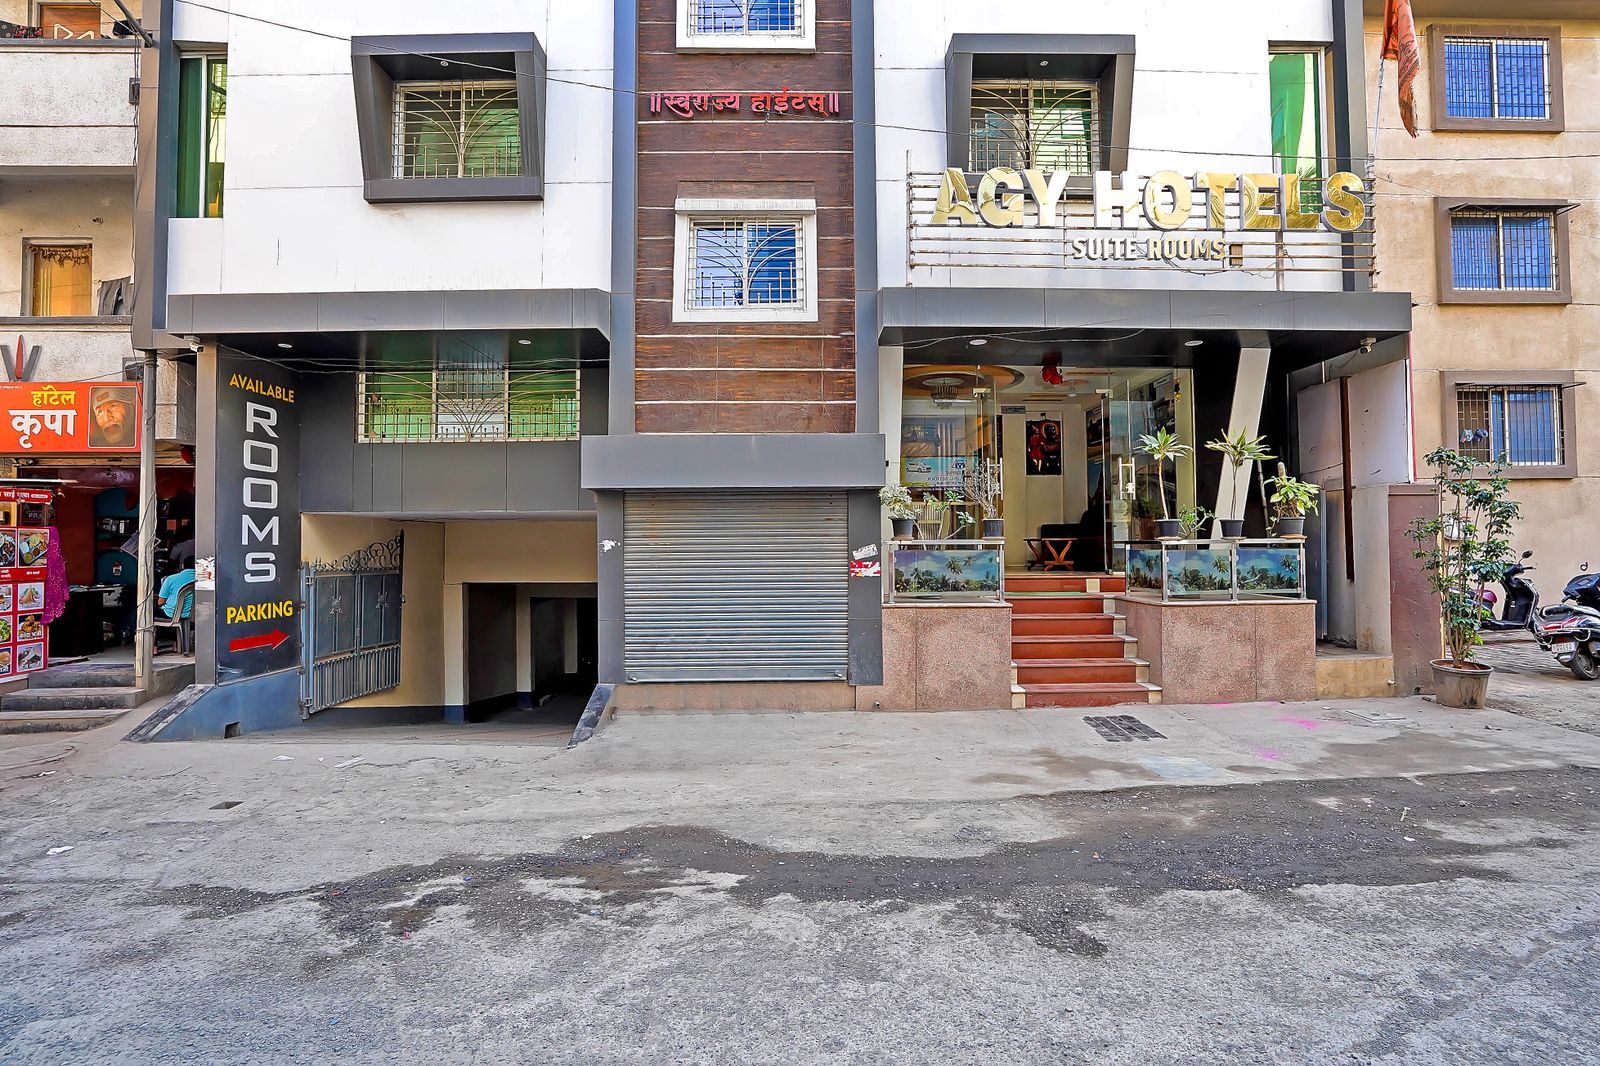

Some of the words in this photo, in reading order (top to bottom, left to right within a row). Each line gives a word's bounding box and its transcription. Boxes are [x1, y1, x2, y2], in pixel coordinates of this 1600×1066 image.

[931, 167, 1070, 228] AGY
[1094, 170, 1365, 233] HOTELS
[1072, 238, 1138, 260] SUITE
[1147, 238, 1228, 262] ROOMS
[31, 384, 77, 407] हॉटेल
[229, 373, 296, 404] AVAILABLE
[8, 409, 78, 449] कृपा
[241, 401, 280, 584] ROOMS
[227, 601, 293, 624] PARKING
